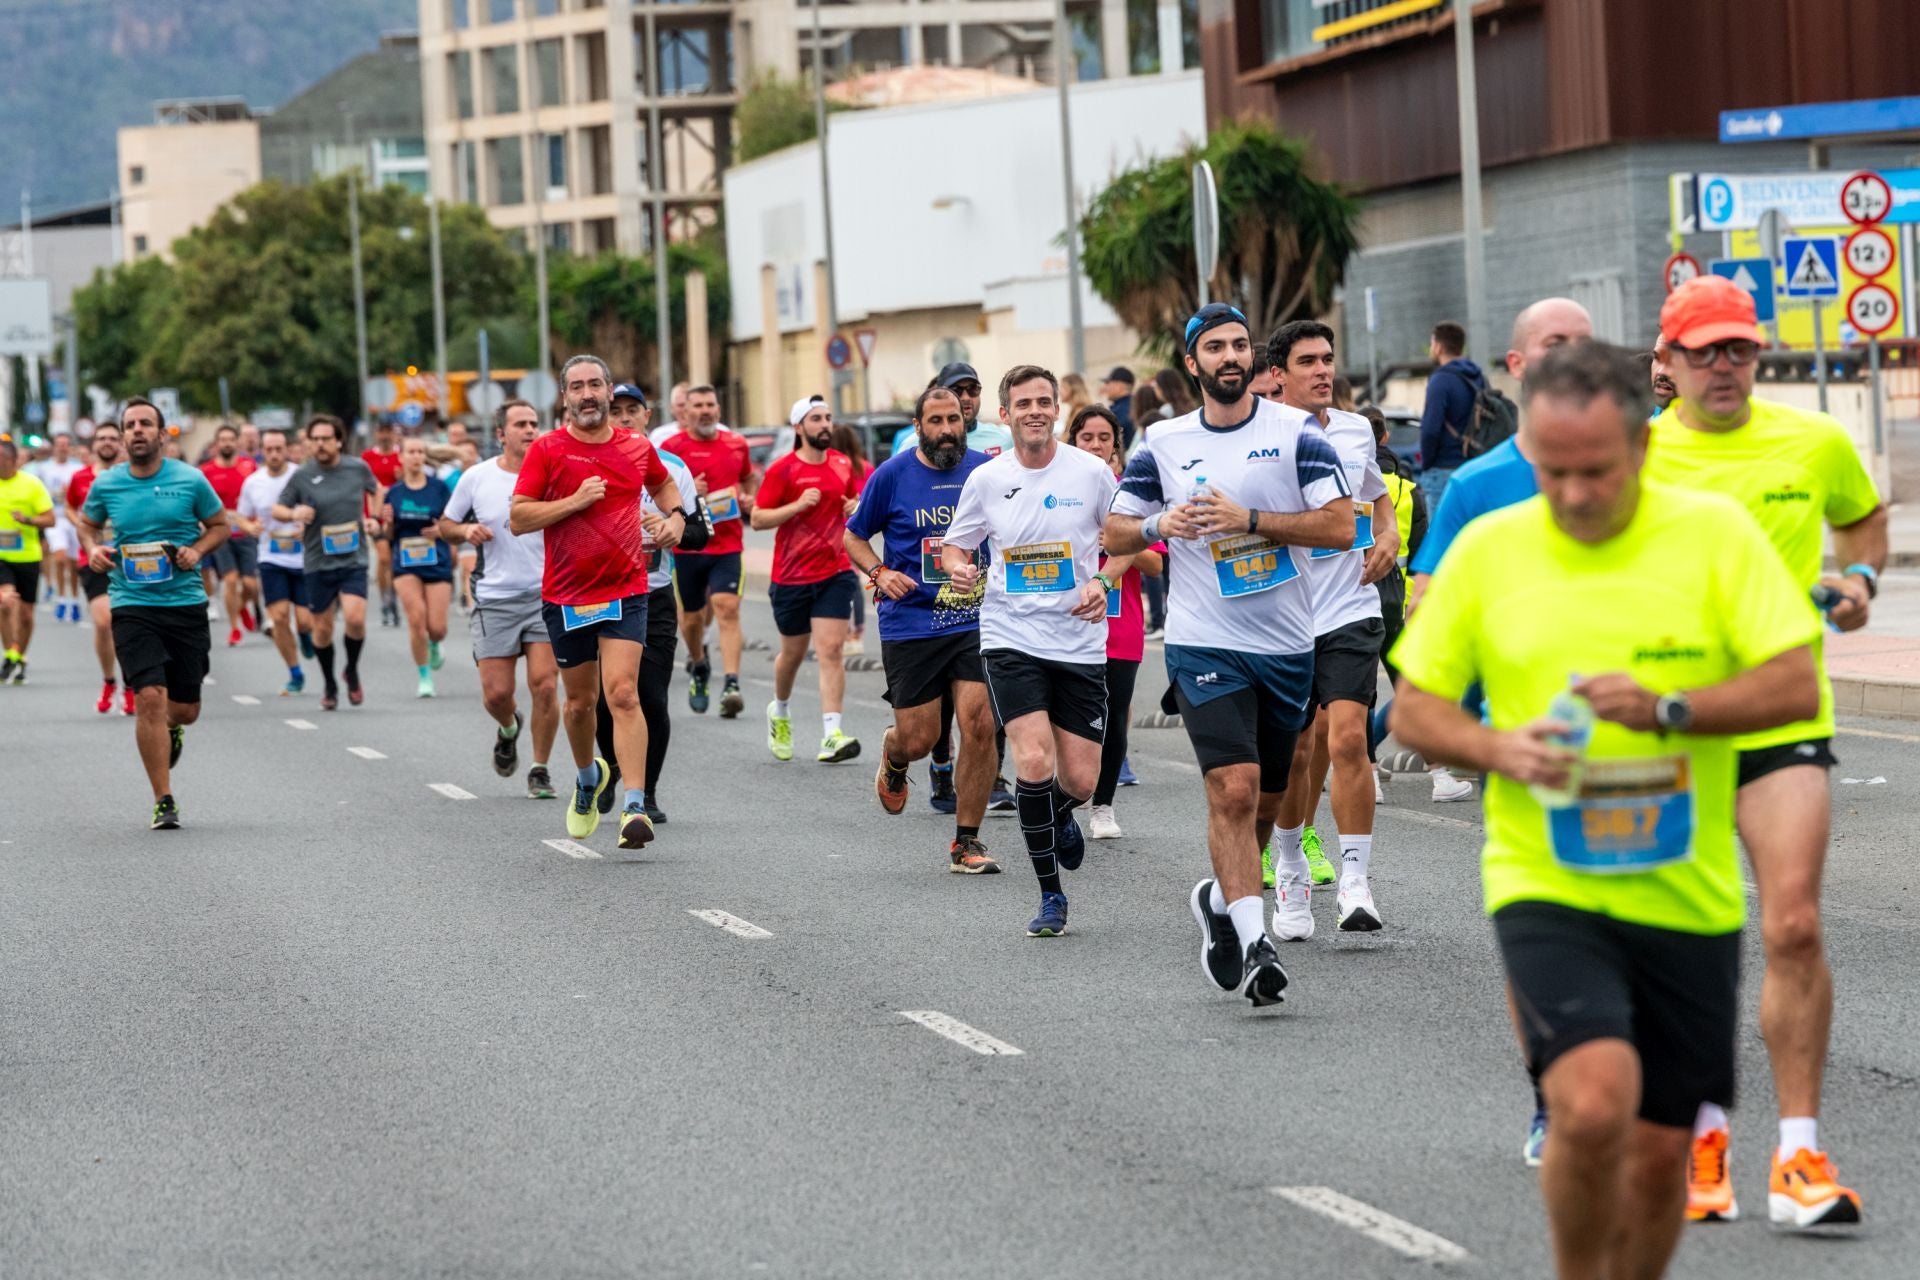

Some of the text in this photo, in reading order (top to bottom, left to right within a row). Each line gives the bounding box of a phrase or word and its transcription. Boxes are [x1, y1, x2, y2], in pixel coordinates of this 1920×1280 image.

[1858, 299, 1888, 319] 20
[1247, 448, 1279, 459] AM
[1021, 551, 1065, 560] EMPRESAS
[1021, 563, 1060, 580] 469
[1233, 553, 1277, 578] 040
